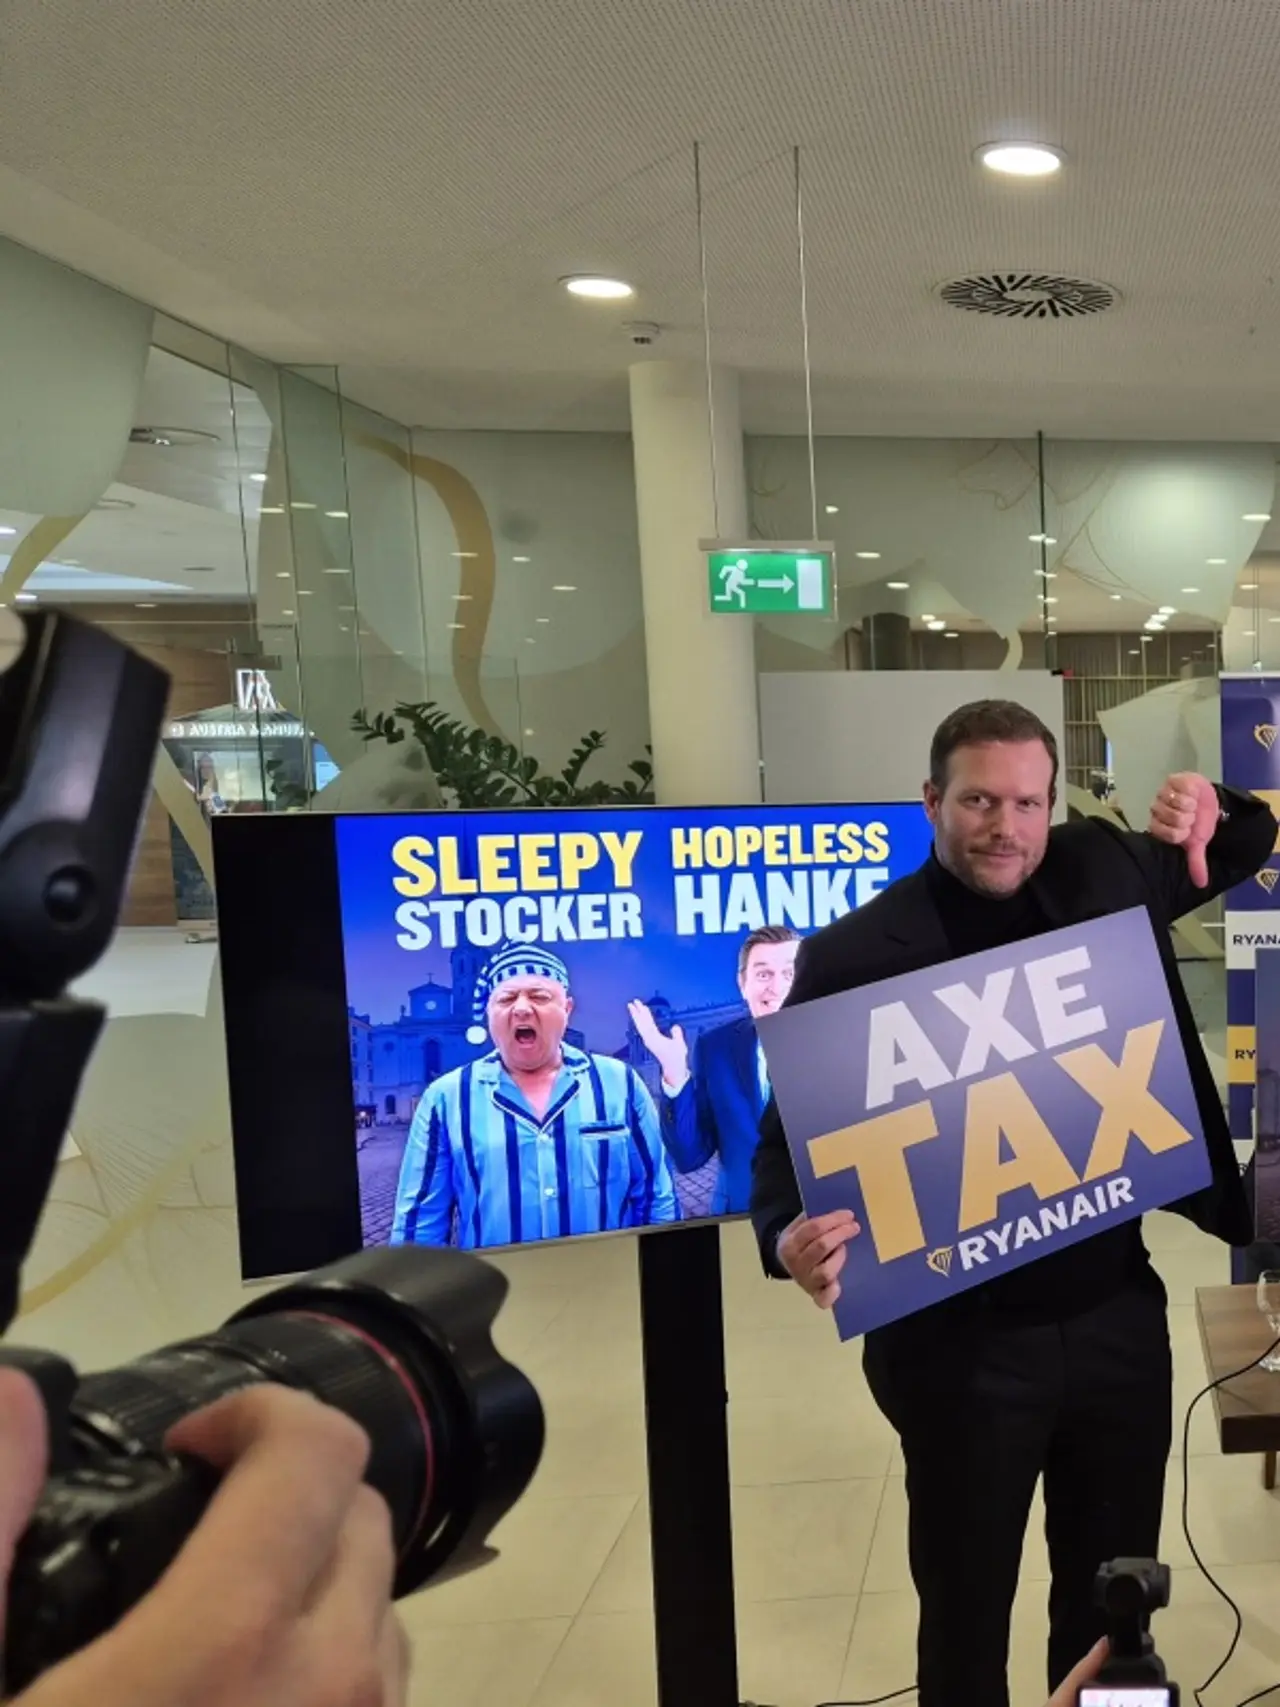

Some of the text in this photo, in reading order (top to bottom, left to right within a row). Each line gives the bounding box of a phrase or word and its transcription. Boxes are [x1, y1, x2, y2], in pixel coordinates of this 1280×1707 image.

[391, 831, 643, 897] SLEEPY
[671, 822, 890, 868] HOPELESS
[396, 893, 644, 950] STOCKER
[866, 946, 1108, 1110] AXE
[806, 1019, 1194, 1264] TAX
[959, 1176, 1135, 1271] RYANAIR
